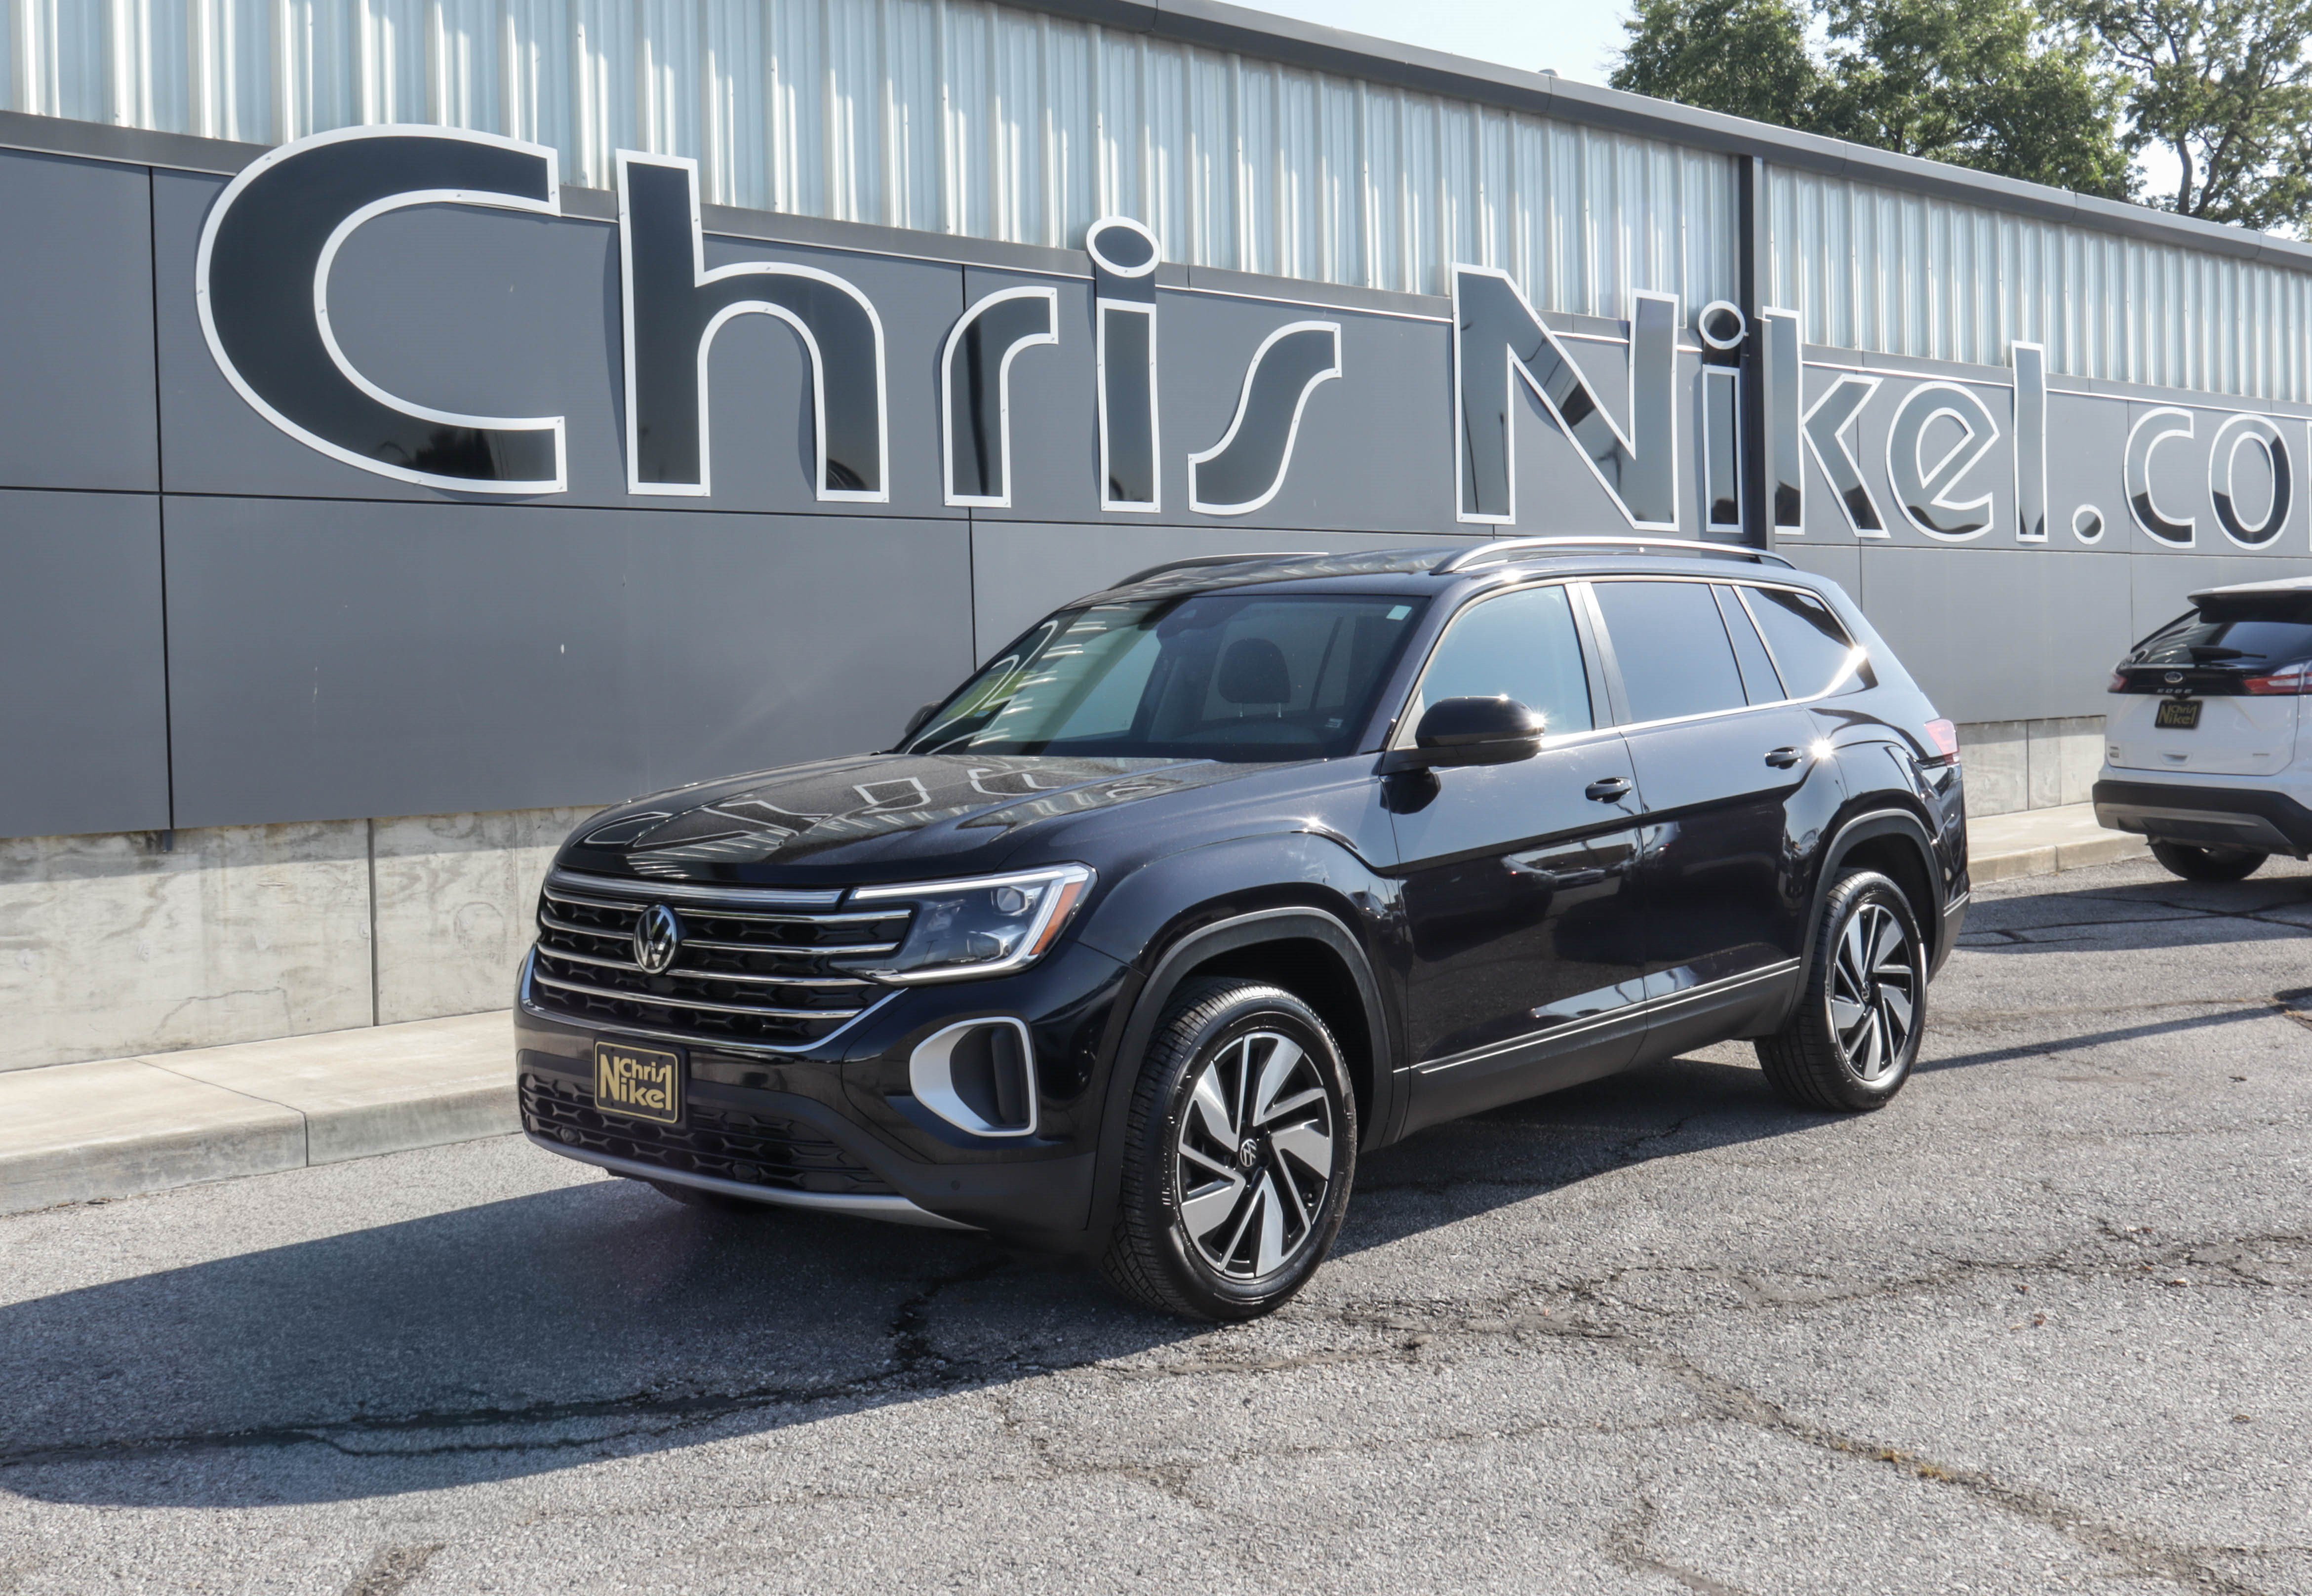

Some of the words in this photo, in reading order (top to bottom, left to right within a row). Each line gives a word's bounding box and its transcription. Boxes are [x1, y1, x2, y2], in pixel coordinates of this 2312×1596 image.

[196, 123, 1342, 515] Chris
[1452, 262, 2312, 551] Nikel.co
[2158, 705, 2198, 724] Nikel
[600, 1054, 672, 1111] Nikel
[620, 1058, 667, 1083] Chris
